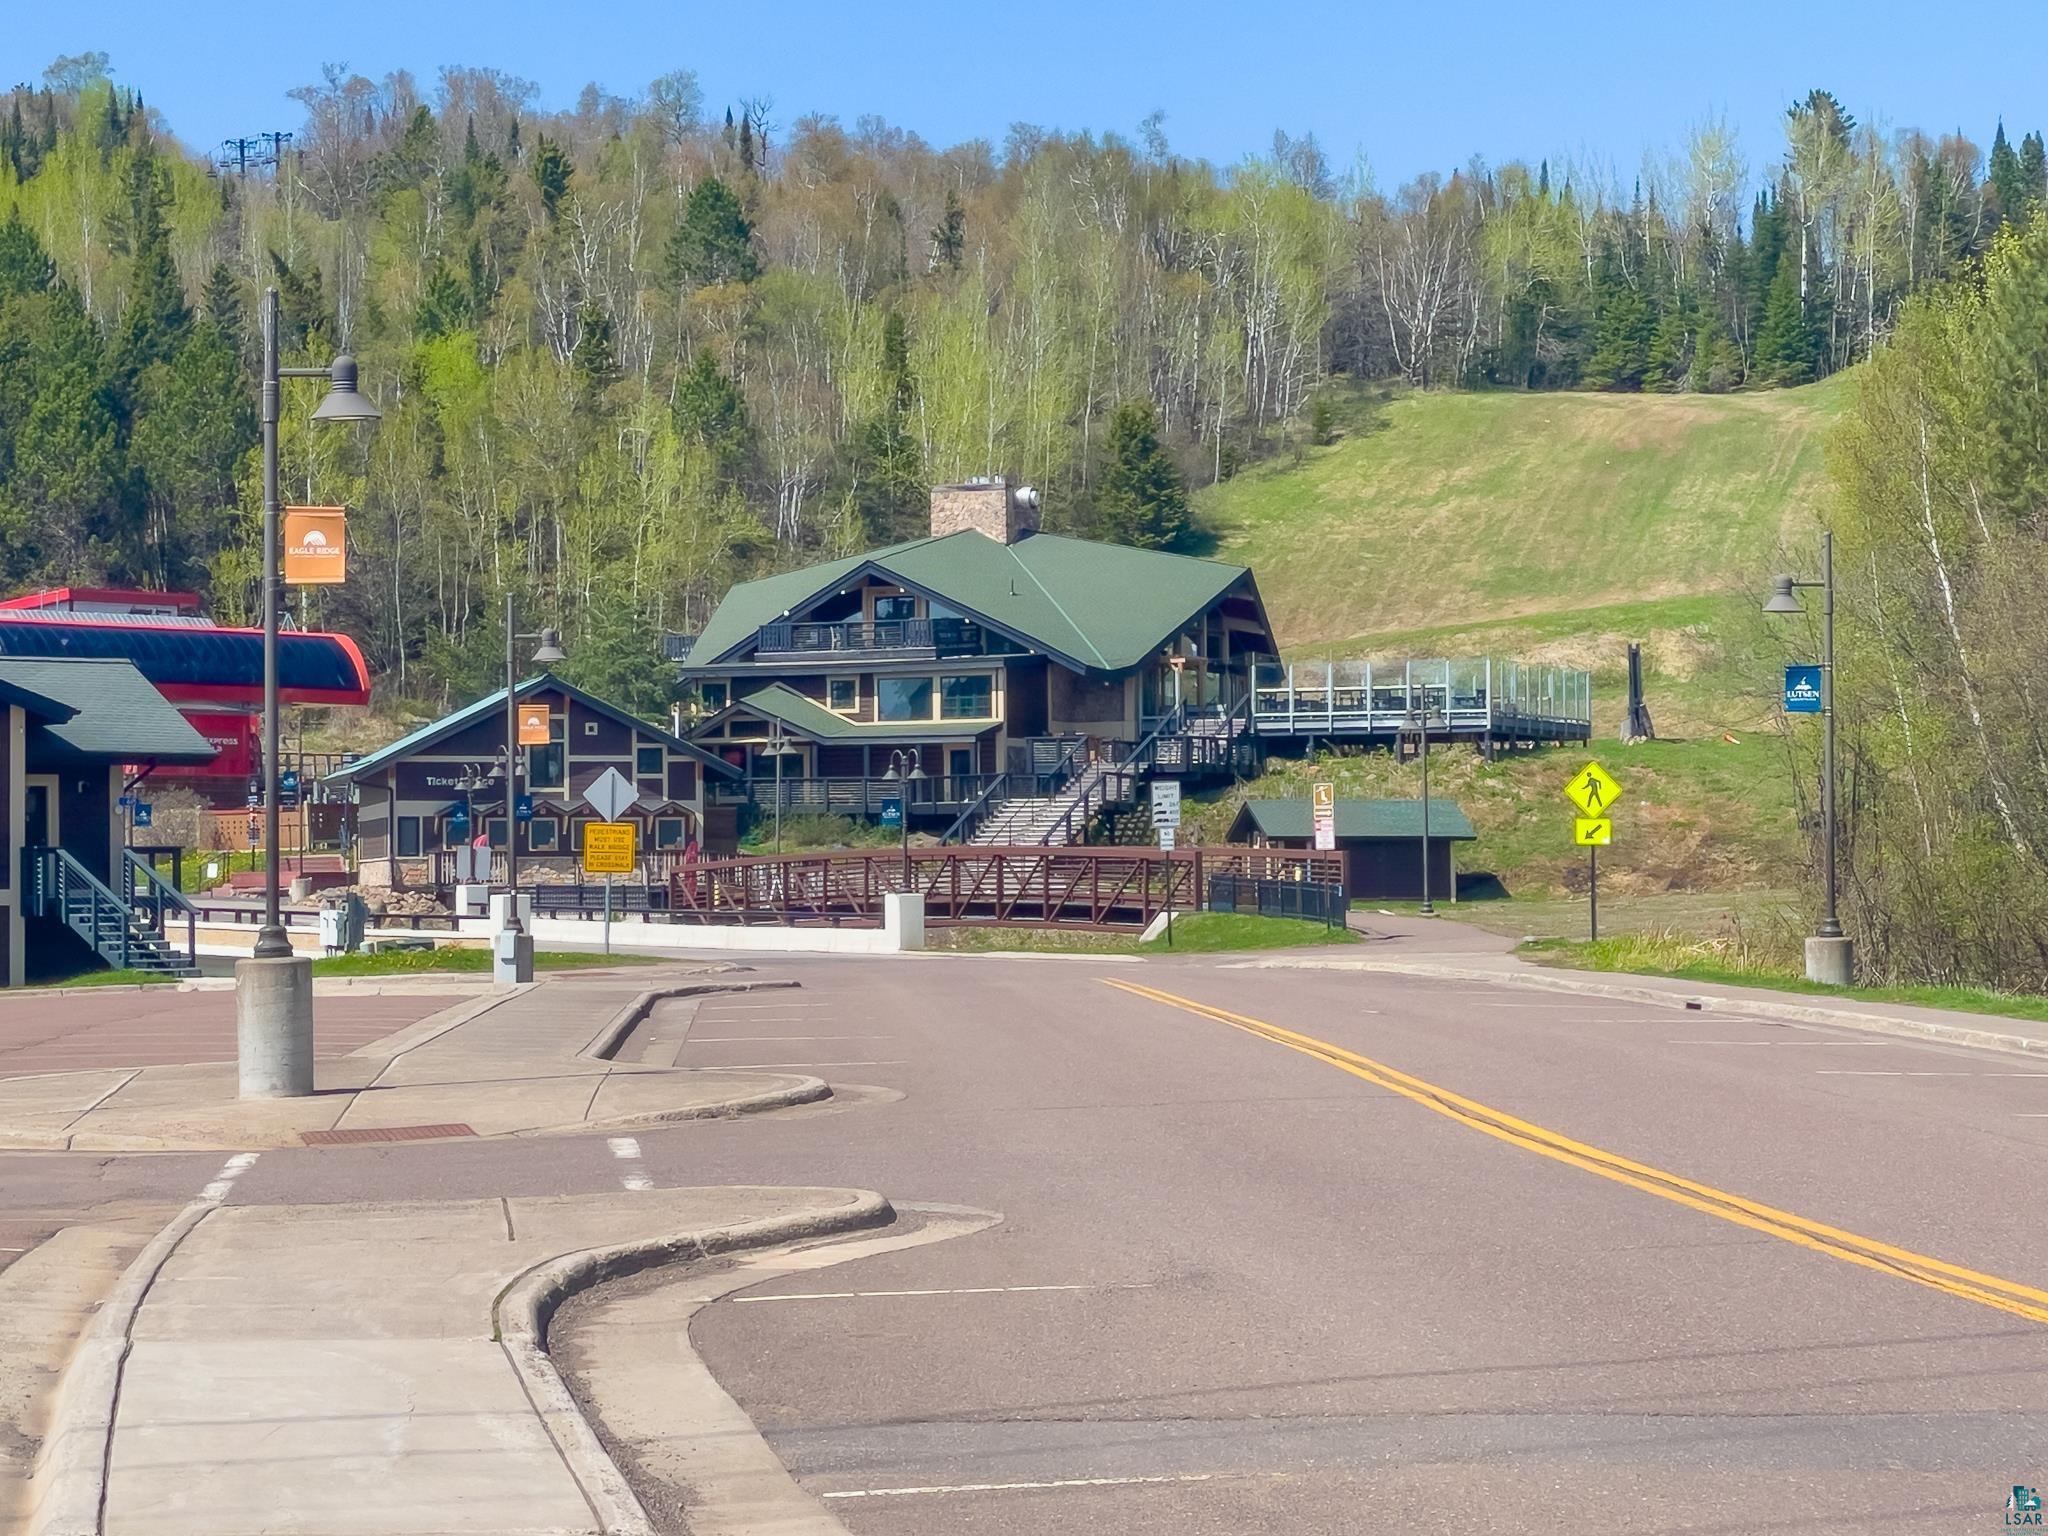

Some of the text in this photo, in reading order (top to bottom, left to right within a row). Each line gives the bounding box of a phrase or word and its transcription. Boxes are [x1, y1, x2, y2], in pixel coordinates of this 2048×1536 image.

[288, 547, 340, 555] EAGLE RIDGE
[1786, 690, 1820, 698] LUTSEN
[207, 737, 239, 747] xpress
[426, 776, 459, 786] Ticket
